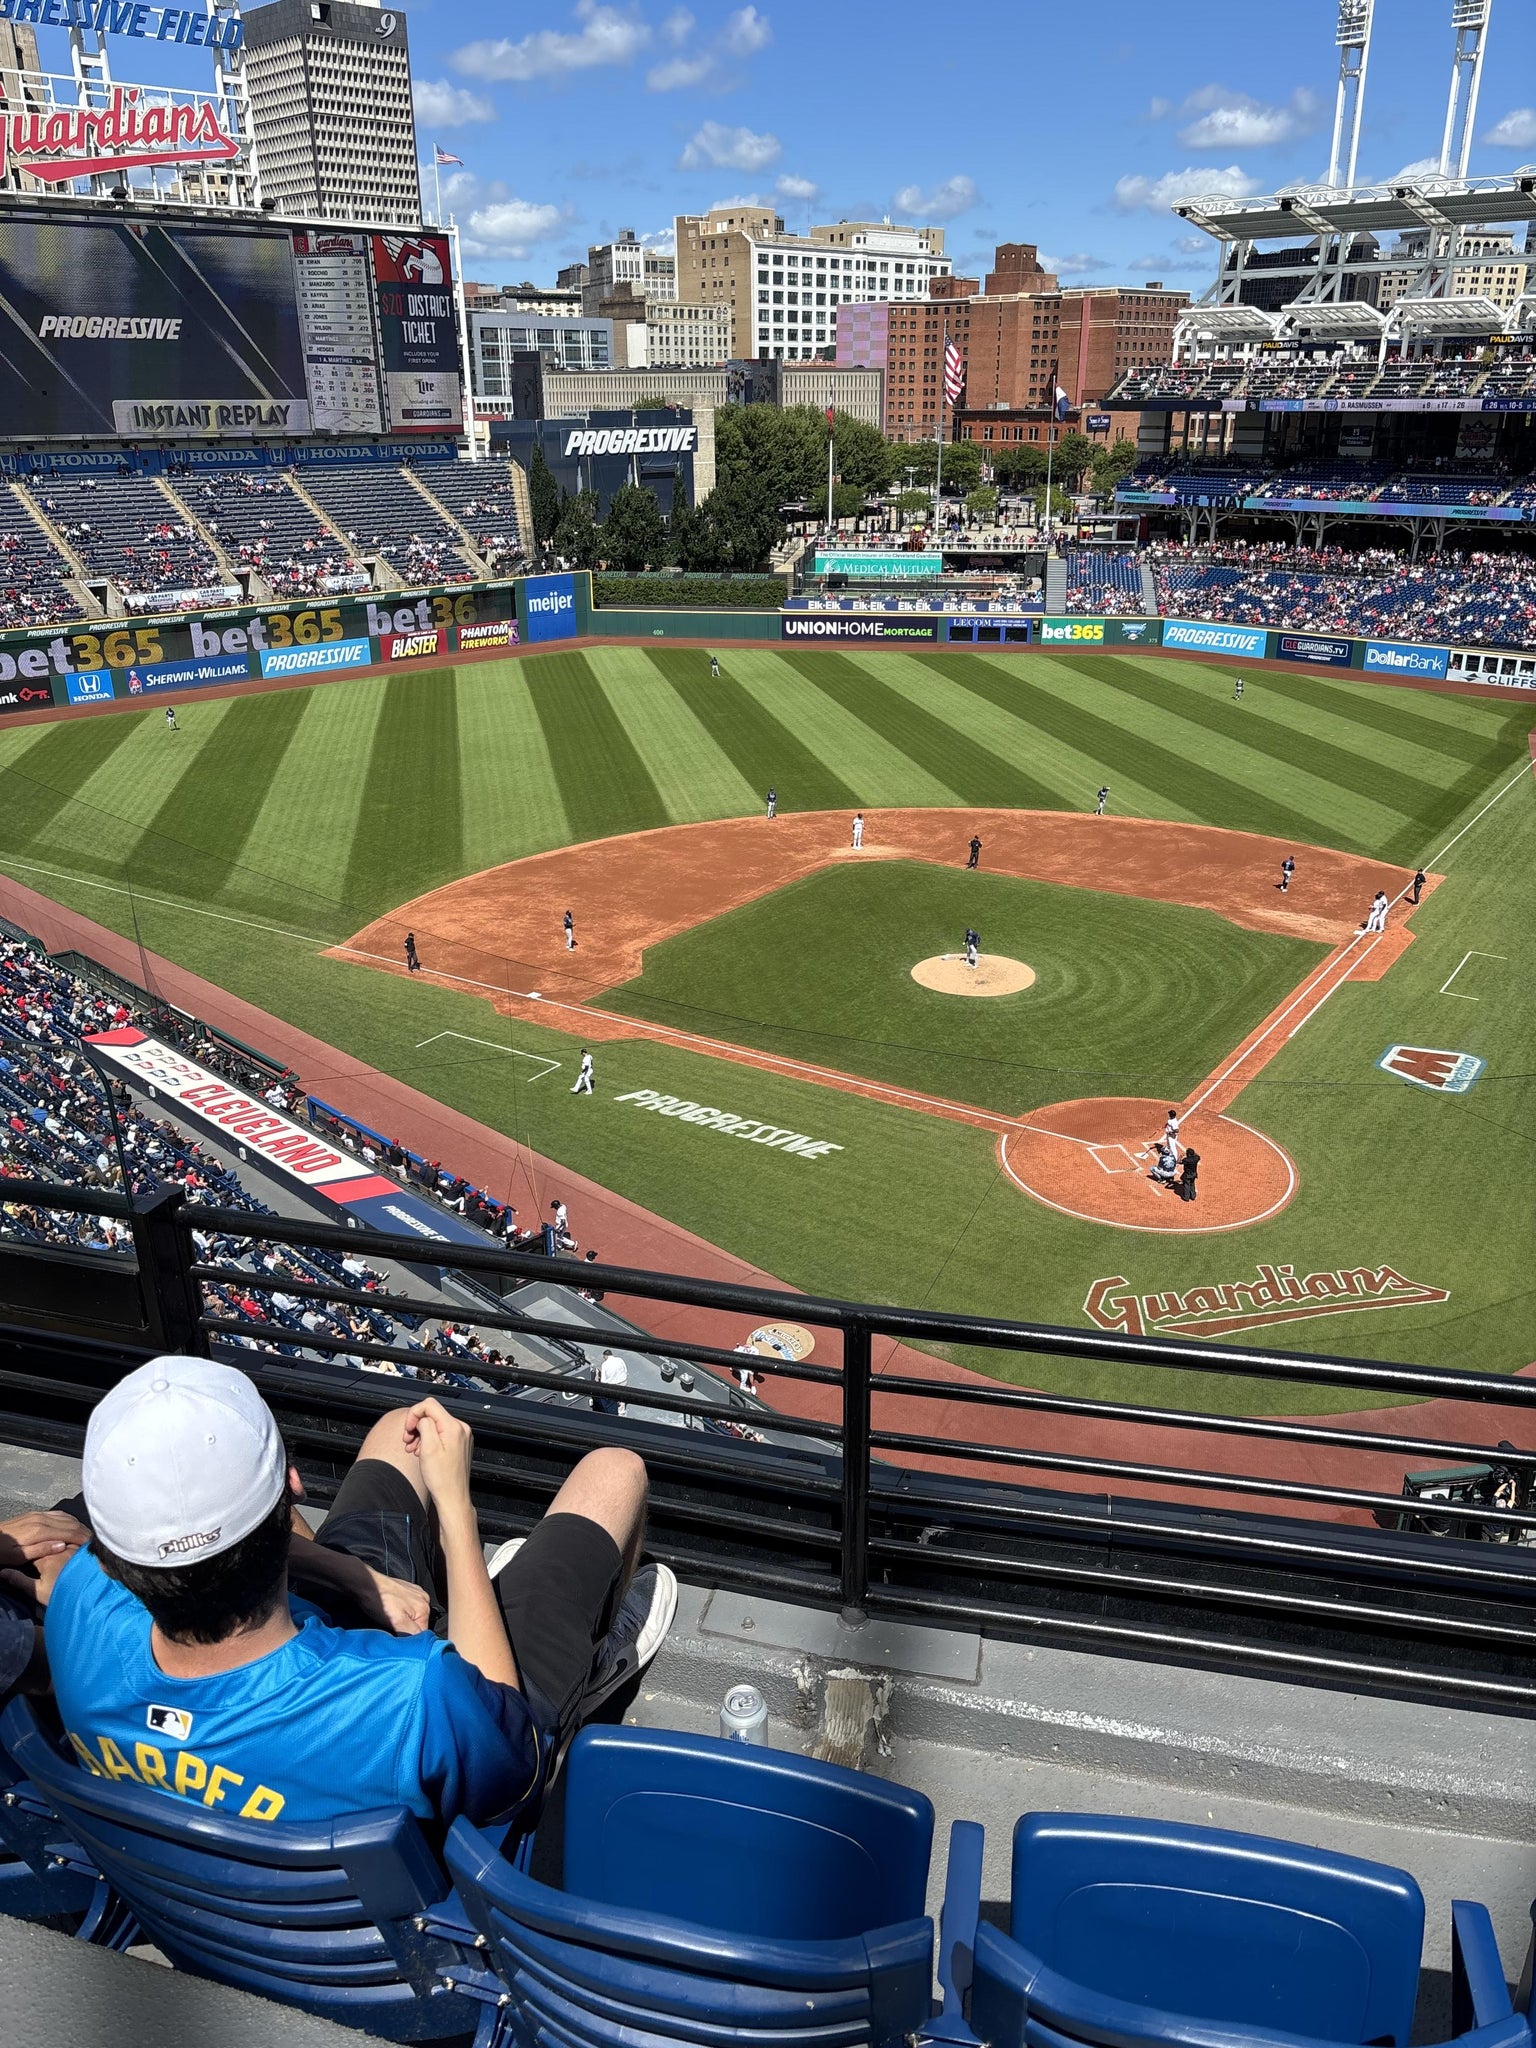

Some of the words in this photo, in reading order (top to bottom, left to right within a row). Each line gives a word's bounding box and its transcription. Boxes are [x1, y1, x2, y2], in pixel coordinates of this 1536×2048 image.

[157, 8, 245, 50] FIELD
[381, 13, 397, 39] 9
[0, 82, 242, 183] uardians
[407, 293, 451, 318] DISTRICT
[38, 315, 183, 340] PROGRESSIVE
[401, 320, 436, 344] TICKET
[414, 378, 435, 395] Lite
[1347, 401, 1383, 409] RASMUSSEN
[1441, 401, 1448, 409] 17
[1456, 401, 1465, 409] 26
[1509, 401, 1523, 409] 10-5
[132, 404, 212, 429] INSTANT
[217, 404, 291, 430] REPLAY
[391, 444, 451, 457] HONDA
[564, 427, 697, 457] PROGRESSIVE
[49, 453, 129, 467] HONDA
[188, 449, 260, 464] HONDA
[310, 447, 374, 460] HONDA
[1207, 495, 1247, 509] THAT
[1451, 508, 1489, 517] PROGRESSIVE
[636, 571, 674, 579] PROGRESSIVE
[400, 589, 431, 598] PROGRESSIVE
[443, 585, 474, 593] PROGRESSIVE
[486, 581, 514, 589] PROGRESSIVE
[306, 599, 339, 608] PROGRESSIVE
[354, 594, 386, 603] PROGRESSIVE
[528, 591, 573, 614] meijer
[203, 610, 240, 619] PROGRESSIVE
[256, 604, 291, 613] PROGRESSIVE
[88, 621, 130, 631] PROGRESSIVE
[147, 616, 187, 625] PROGRESSIVE
[27, 627, 71, 637] PROGRESSIVE
[189, 608, 344, 658] bet365
[460, 623, 508, 639] PHANTOM
[883, 628, 933, 637] MORTGAGE
[1042, 623, 1104, 640] bet365
[1165, 626, 1259, 650] PROGRESSIVE
[391, 634, 438, 658] BLASTER
[460, 635, 508, 650] FIREWORKS
[265, 645, 365, 673] PROGRESSIVE
[73, 692, 111, 702] HONDA
[1446, 1057, 1479, 1091] Marathon
[179, 1083, 343, 1174] CLEVELAND
[613, 1088, 846, 1160] PROGRESSIVE
[381, 1204, 437, 1238] PROGRESSIVE
[1082, 1264, 1451, 1339] Guardians
[157, 1526, 223, 1560] Phillies
